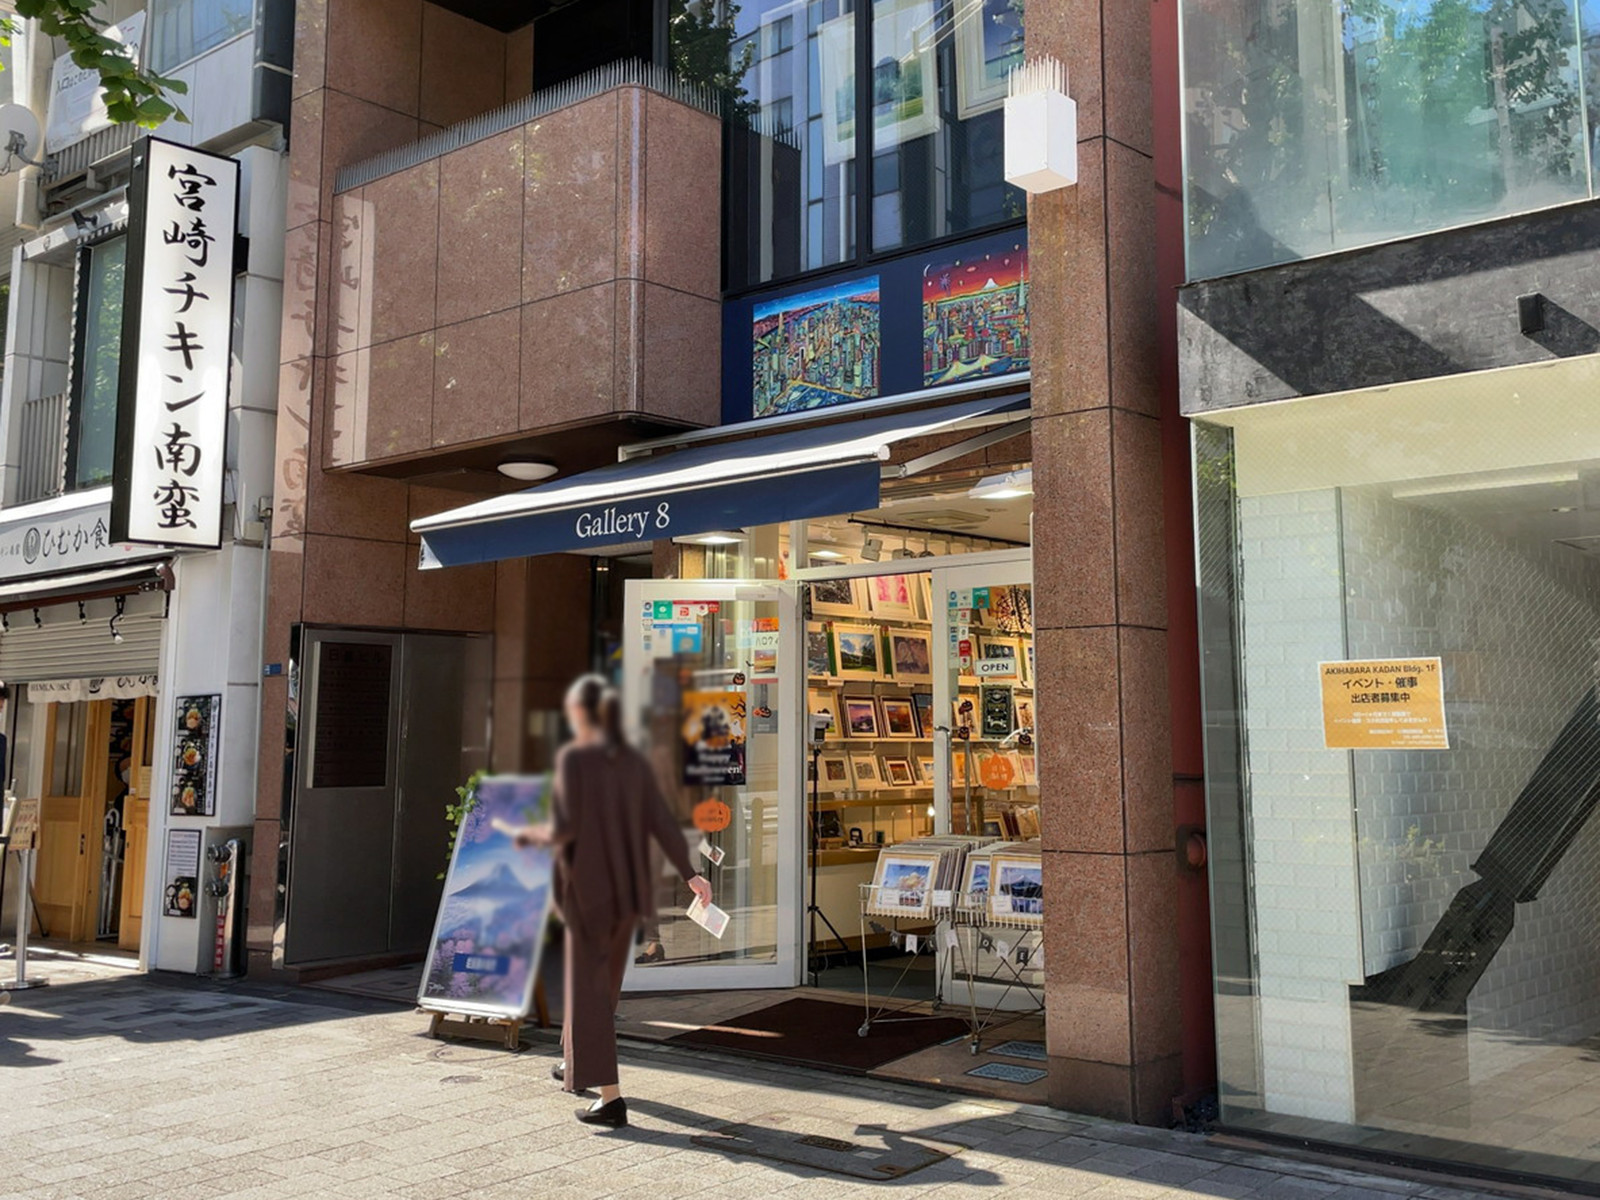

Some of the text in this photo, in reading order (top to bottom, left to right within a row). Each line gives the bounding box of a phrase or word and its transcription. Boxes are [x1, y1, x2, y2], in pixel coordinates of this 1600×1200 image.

[153, 162, 217, 530] 宮崎チキン南蛮
[575, 501, 670, 539] Gallery 8
[42, 517, 109, 557] ひむか食
[981, 663, 1009, 672] OPEN
[1325, 664, 1437, 675] AKIHABARA KADAN Bldg. 1F
[1342, 676, 1418, 688] イベント・催事
[1350, 692, 1410, 704] 出店者募集中
